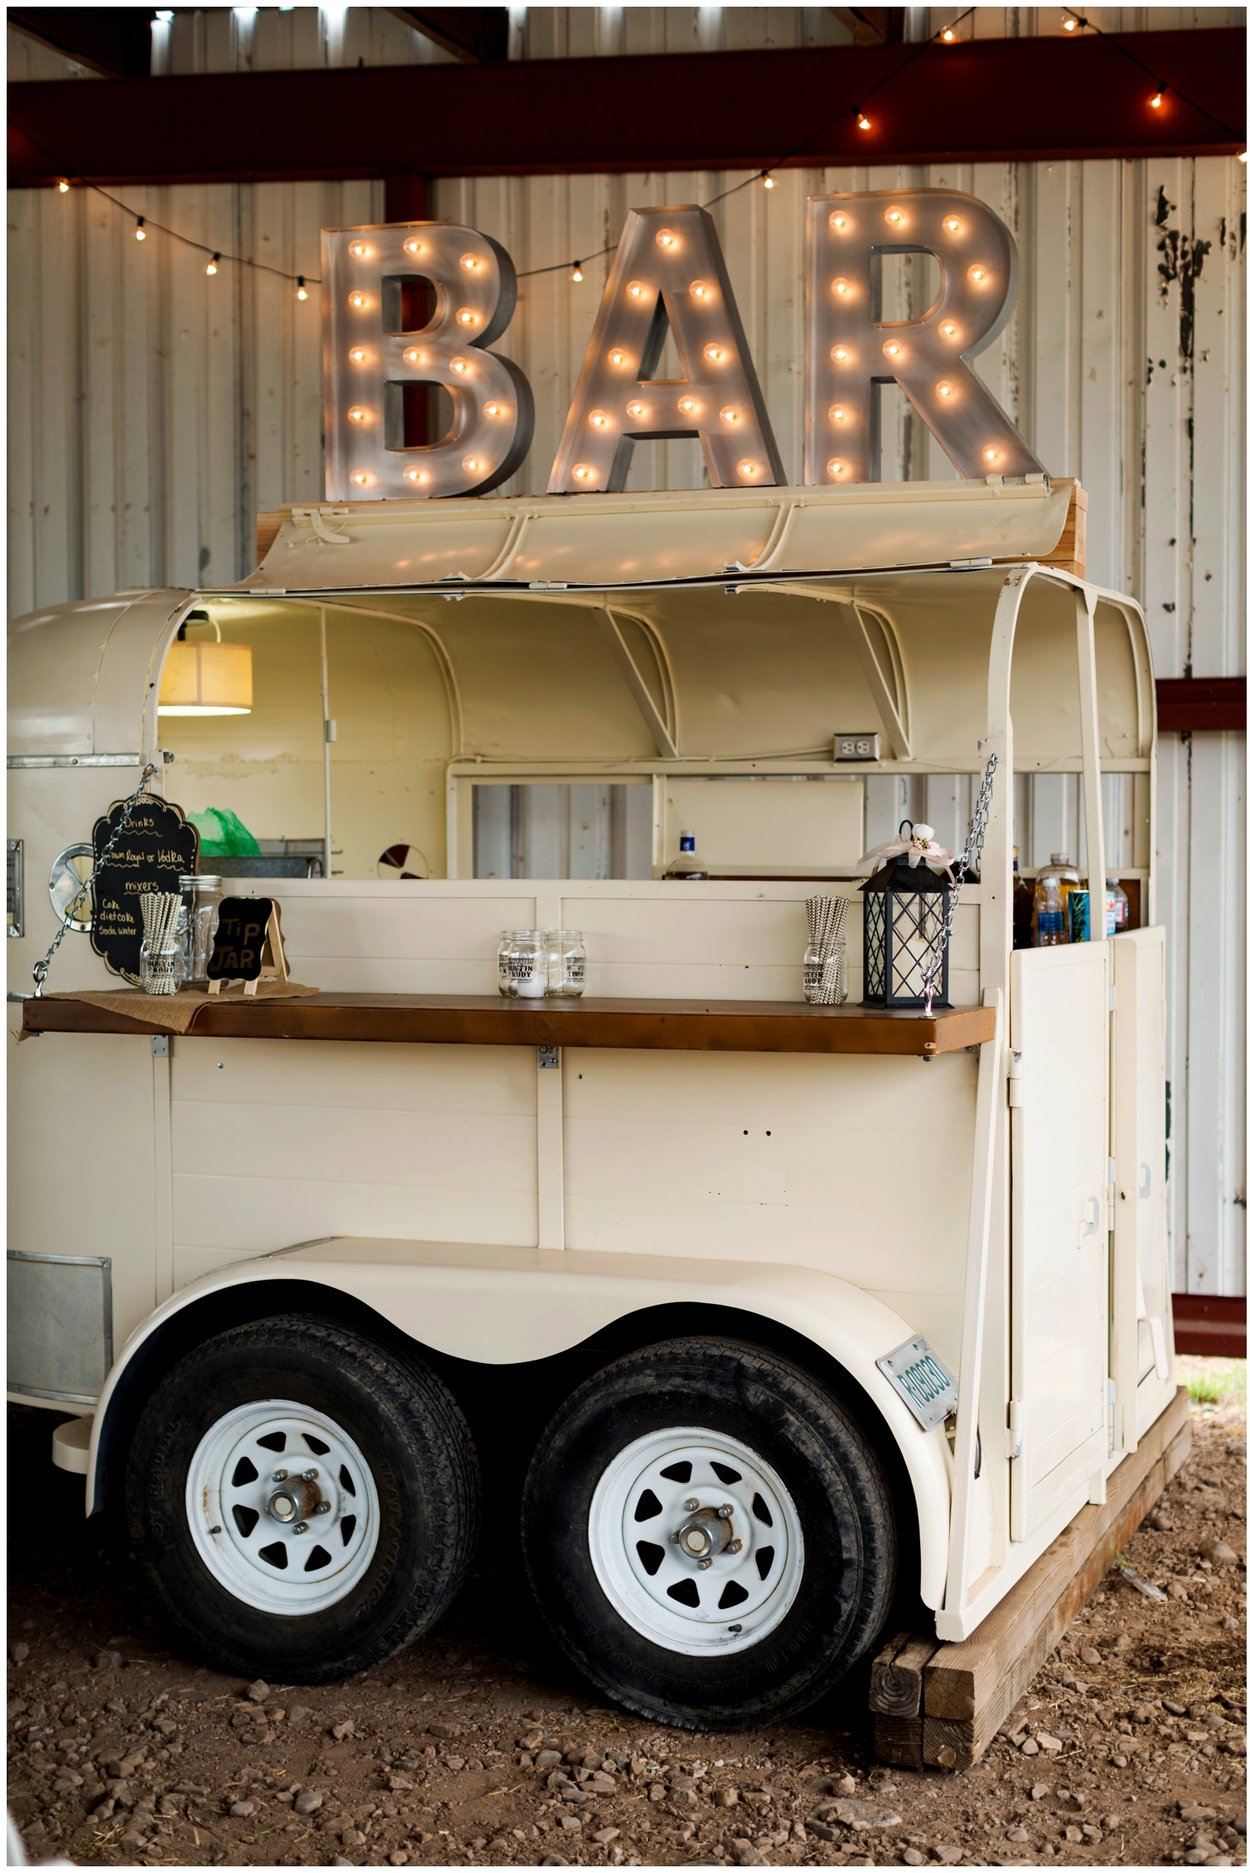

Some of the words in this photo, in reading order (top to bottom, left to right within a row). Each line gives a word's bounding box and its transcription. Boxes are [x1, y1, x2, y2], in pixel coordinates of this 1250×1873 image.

[321, 187, 1050, 501] BAR
[124, 816, 154, 828] Drinks
[126, 849, 145, 868] Royal
[157, 849, 185, 864] Vodka
[125, 881, 159, 892] mixers
[102, 898, 120, 910] Coke
[100, 910, 116, 921] diet
[208, 945, 255, 973] JAR
